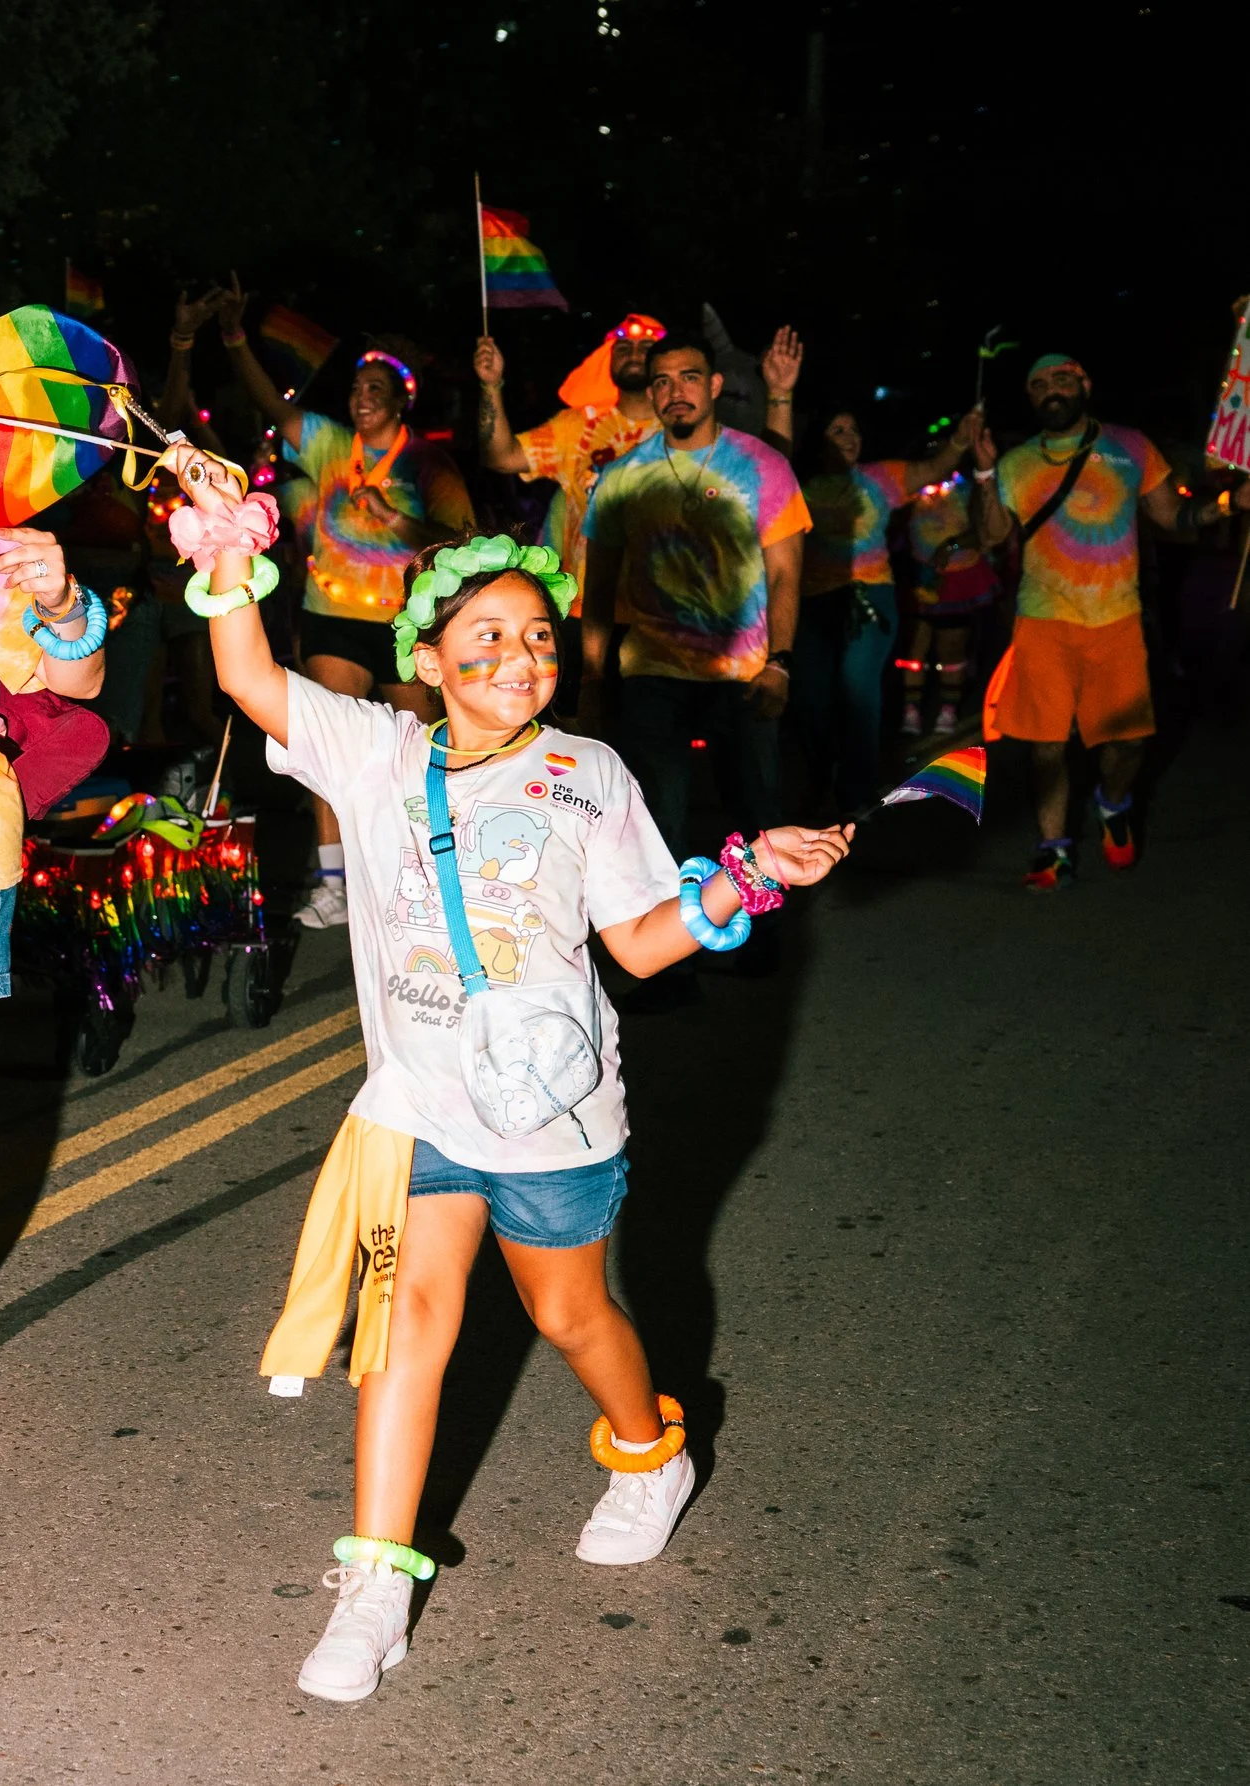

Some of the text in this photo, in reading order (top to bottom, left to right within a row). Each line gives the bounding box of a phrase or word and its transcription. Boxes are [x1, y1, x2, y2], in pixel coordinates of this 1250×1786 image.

[1212, 405, 1250, 470] MA
[553, 783, 573, 794] the
[552, 791, 603, 820] center
[387, 974, 451, 1011] Hello
[411, 1011, 442, 1026] And
[371, 1223, 396, 1247] the
